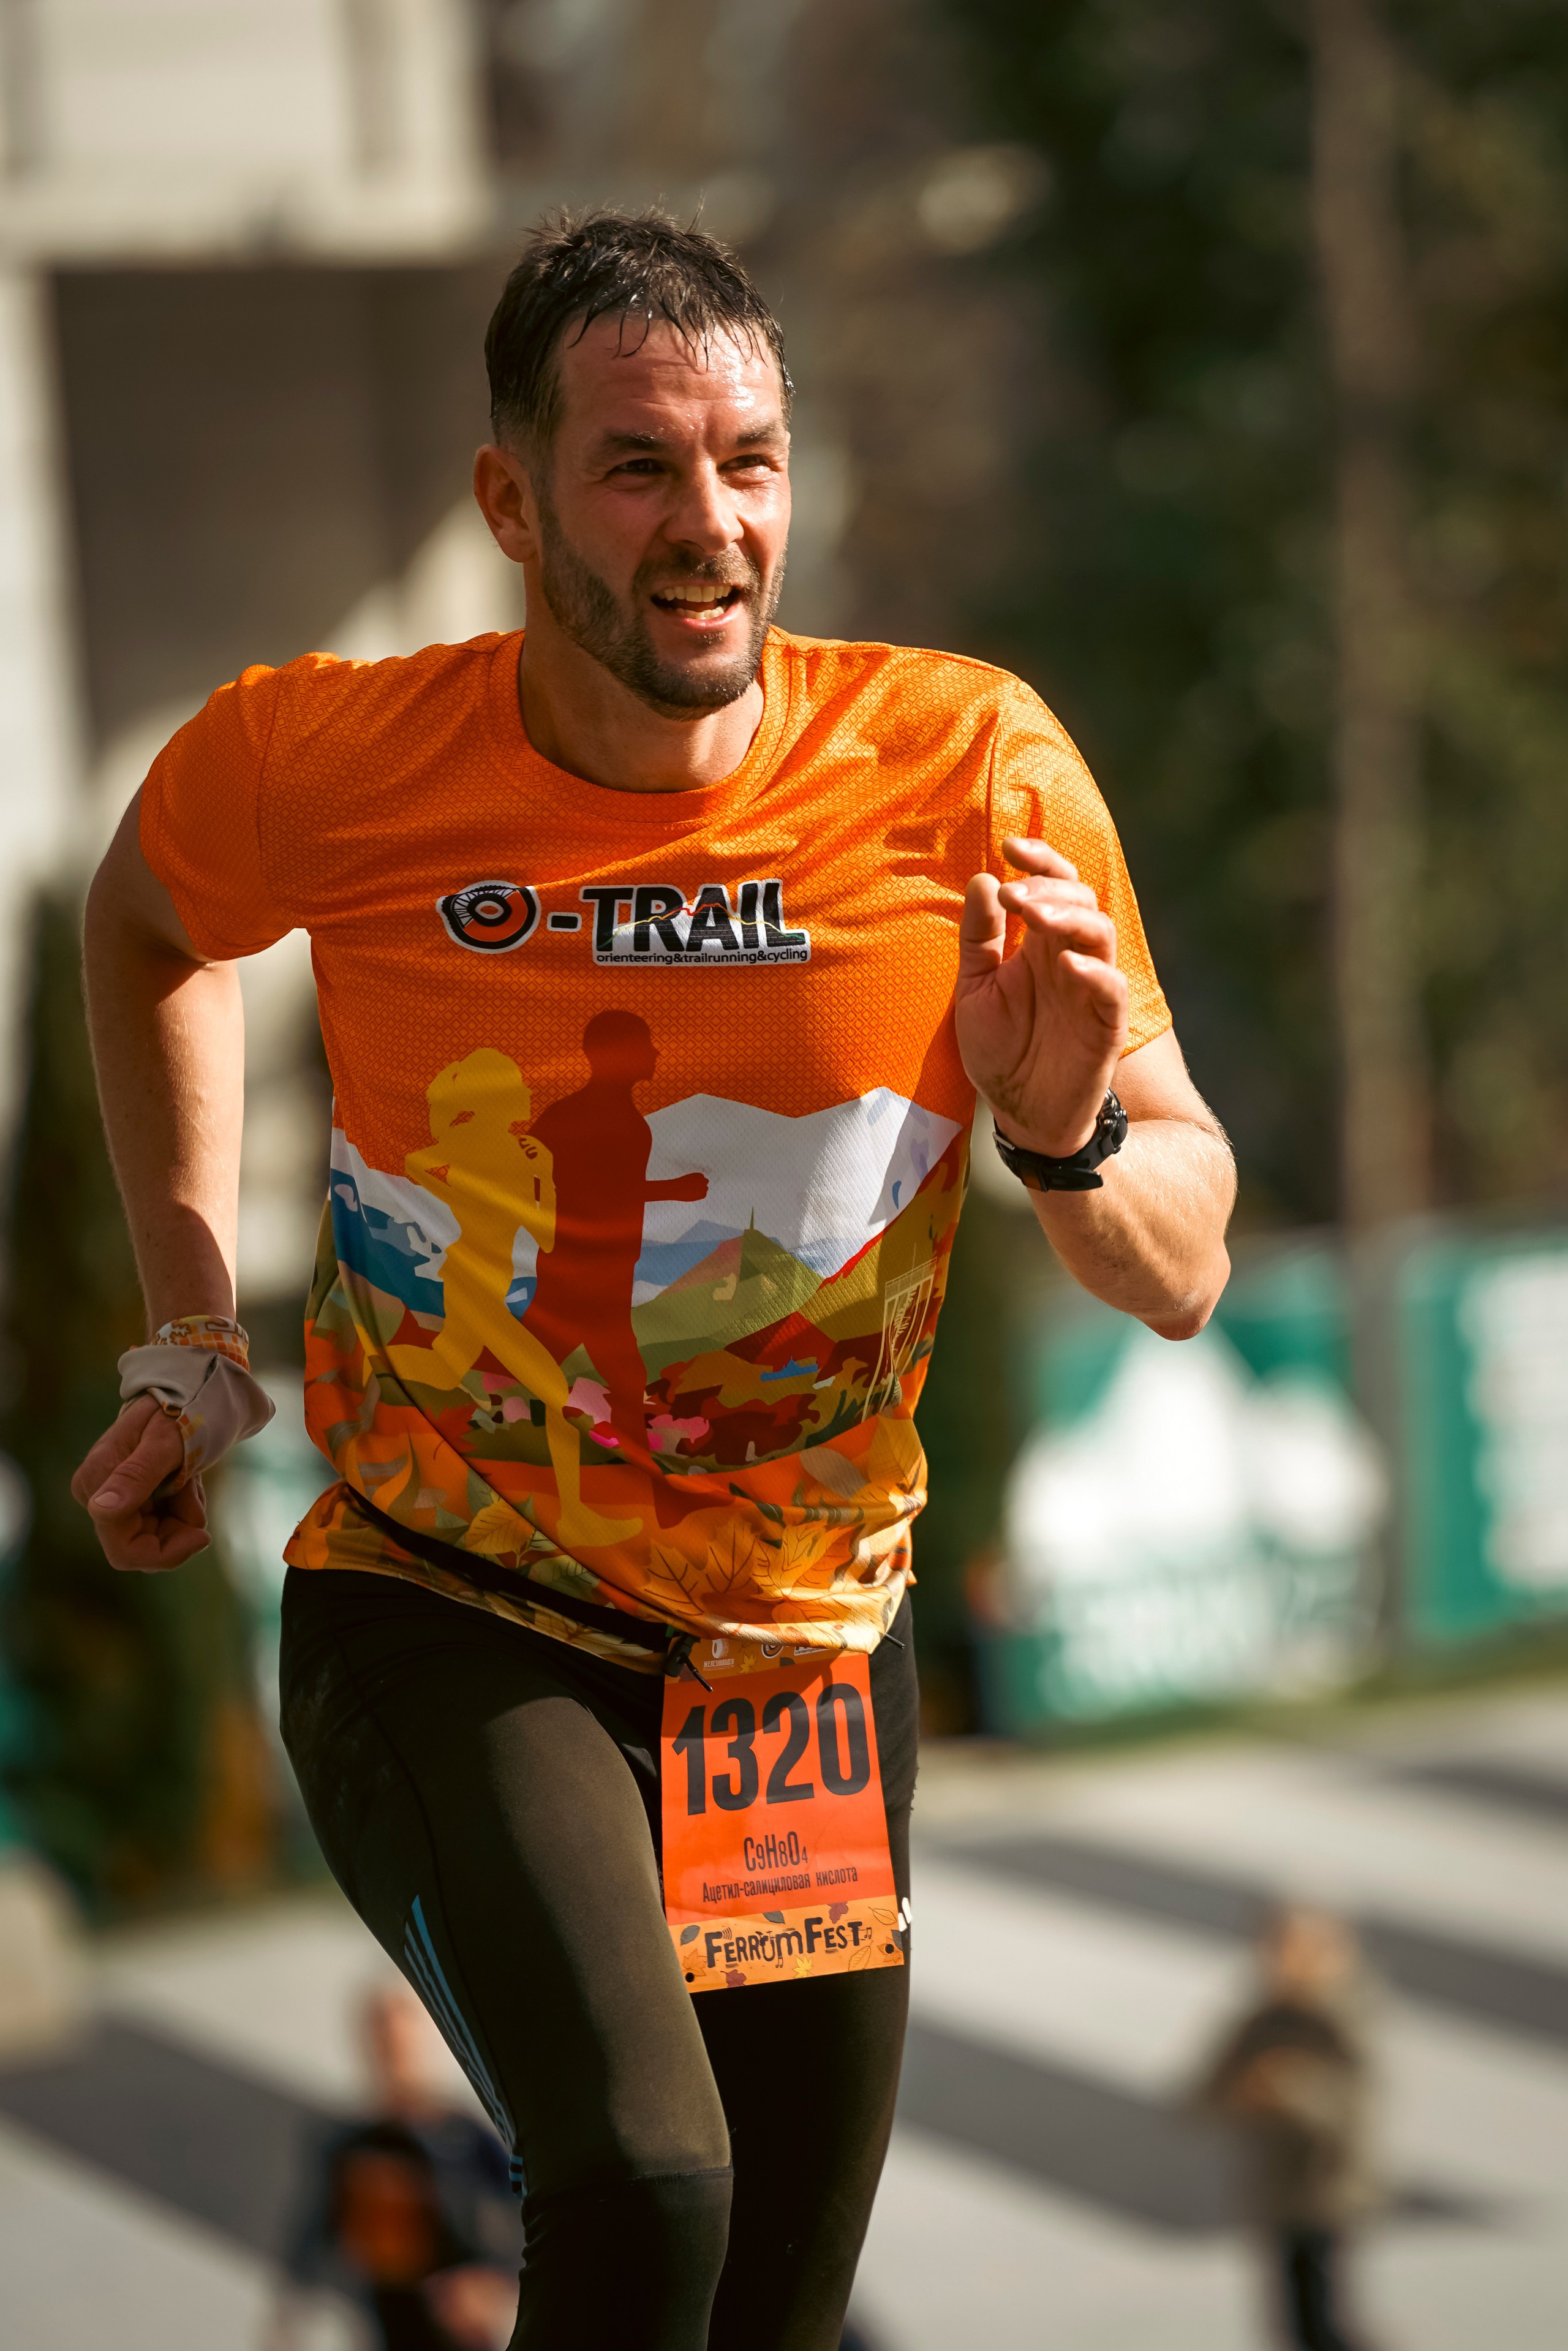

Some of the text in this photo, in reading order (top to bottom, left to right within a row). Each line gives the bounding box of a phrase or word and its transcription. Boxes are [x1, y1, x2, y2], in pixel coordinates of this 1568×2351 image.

[597, 949, 807, 964] orienteering&trailrunning&cycling
[672, 1683, 870, 1816] 1320
[703, 1866, 858, 1904] Ацетил-салициловая кислота
